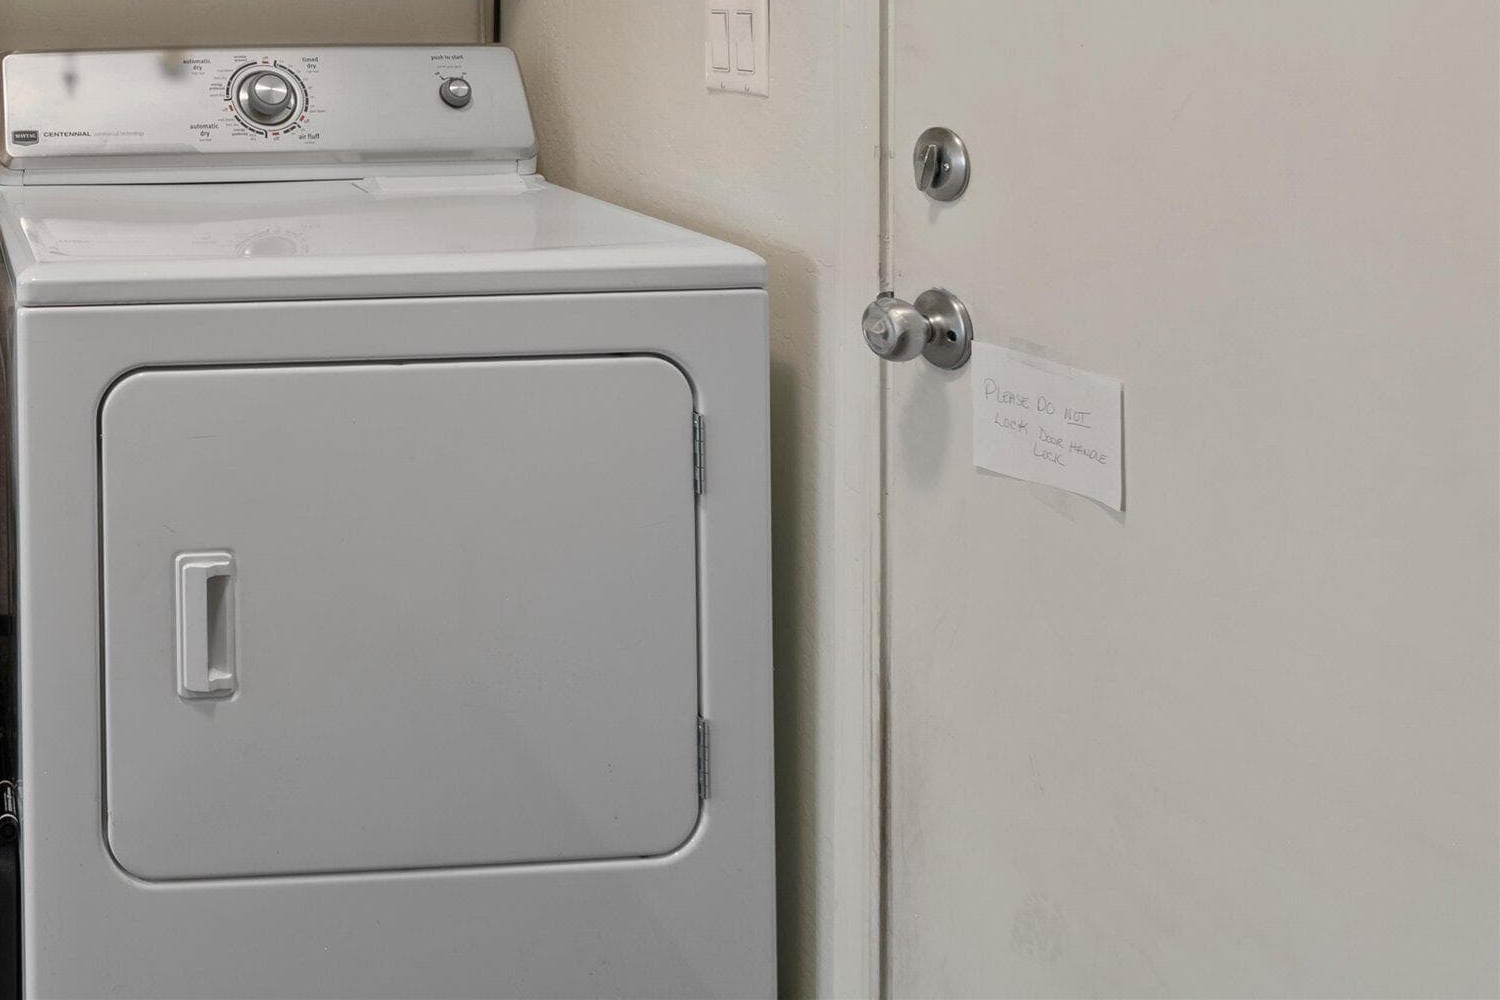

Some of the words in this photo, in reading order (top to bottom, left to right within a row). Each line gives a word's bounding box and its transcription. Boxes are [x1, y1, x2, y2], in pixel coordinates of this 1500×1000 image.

[983, 378, 1030, 410] PLEASE
[1037, 396, 1055, 415] DO
[1064, 408, 1091, 422] NOT
